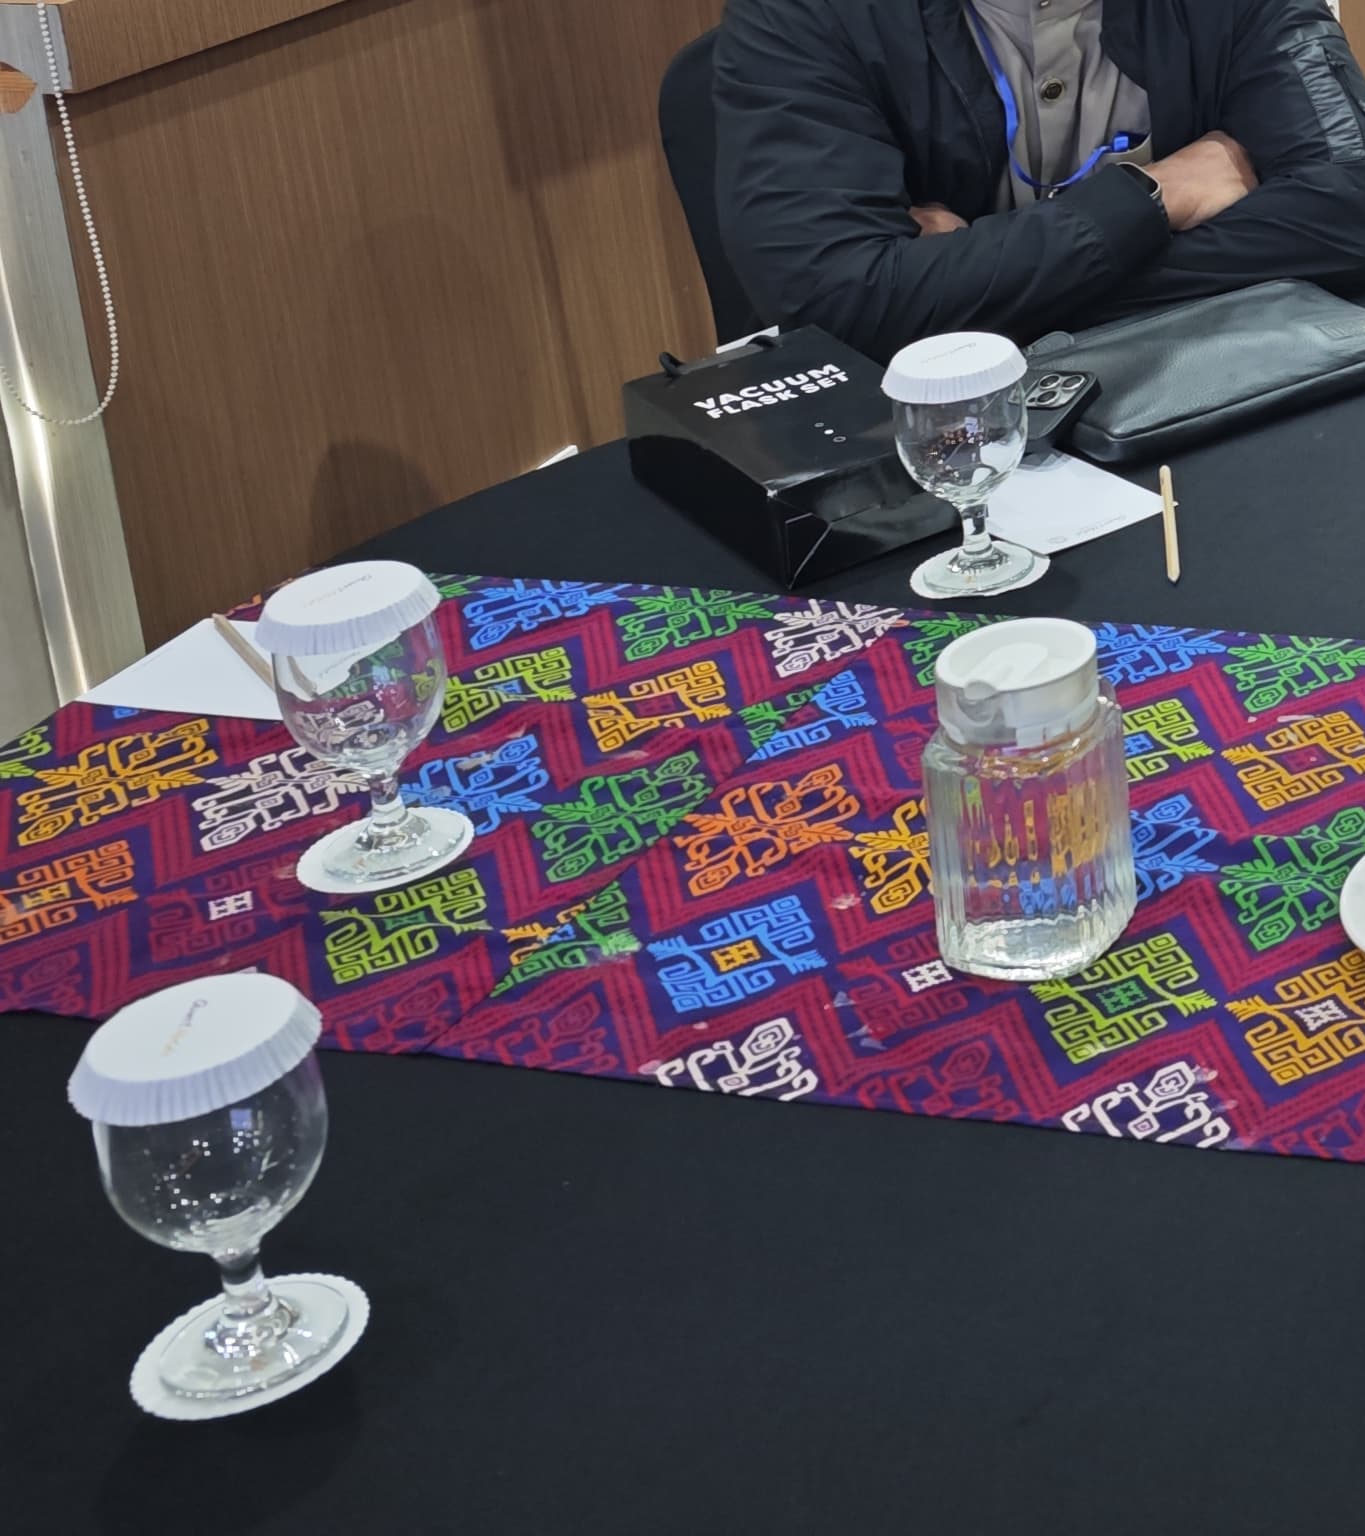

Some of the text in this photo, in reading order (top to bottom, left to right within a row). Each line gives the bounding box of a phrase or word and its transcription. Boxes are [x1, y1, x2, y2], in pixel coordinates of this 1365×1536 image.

[693, 363, 841, 410] VACUUM
[706, 371, 849, 419] FLASK SET
